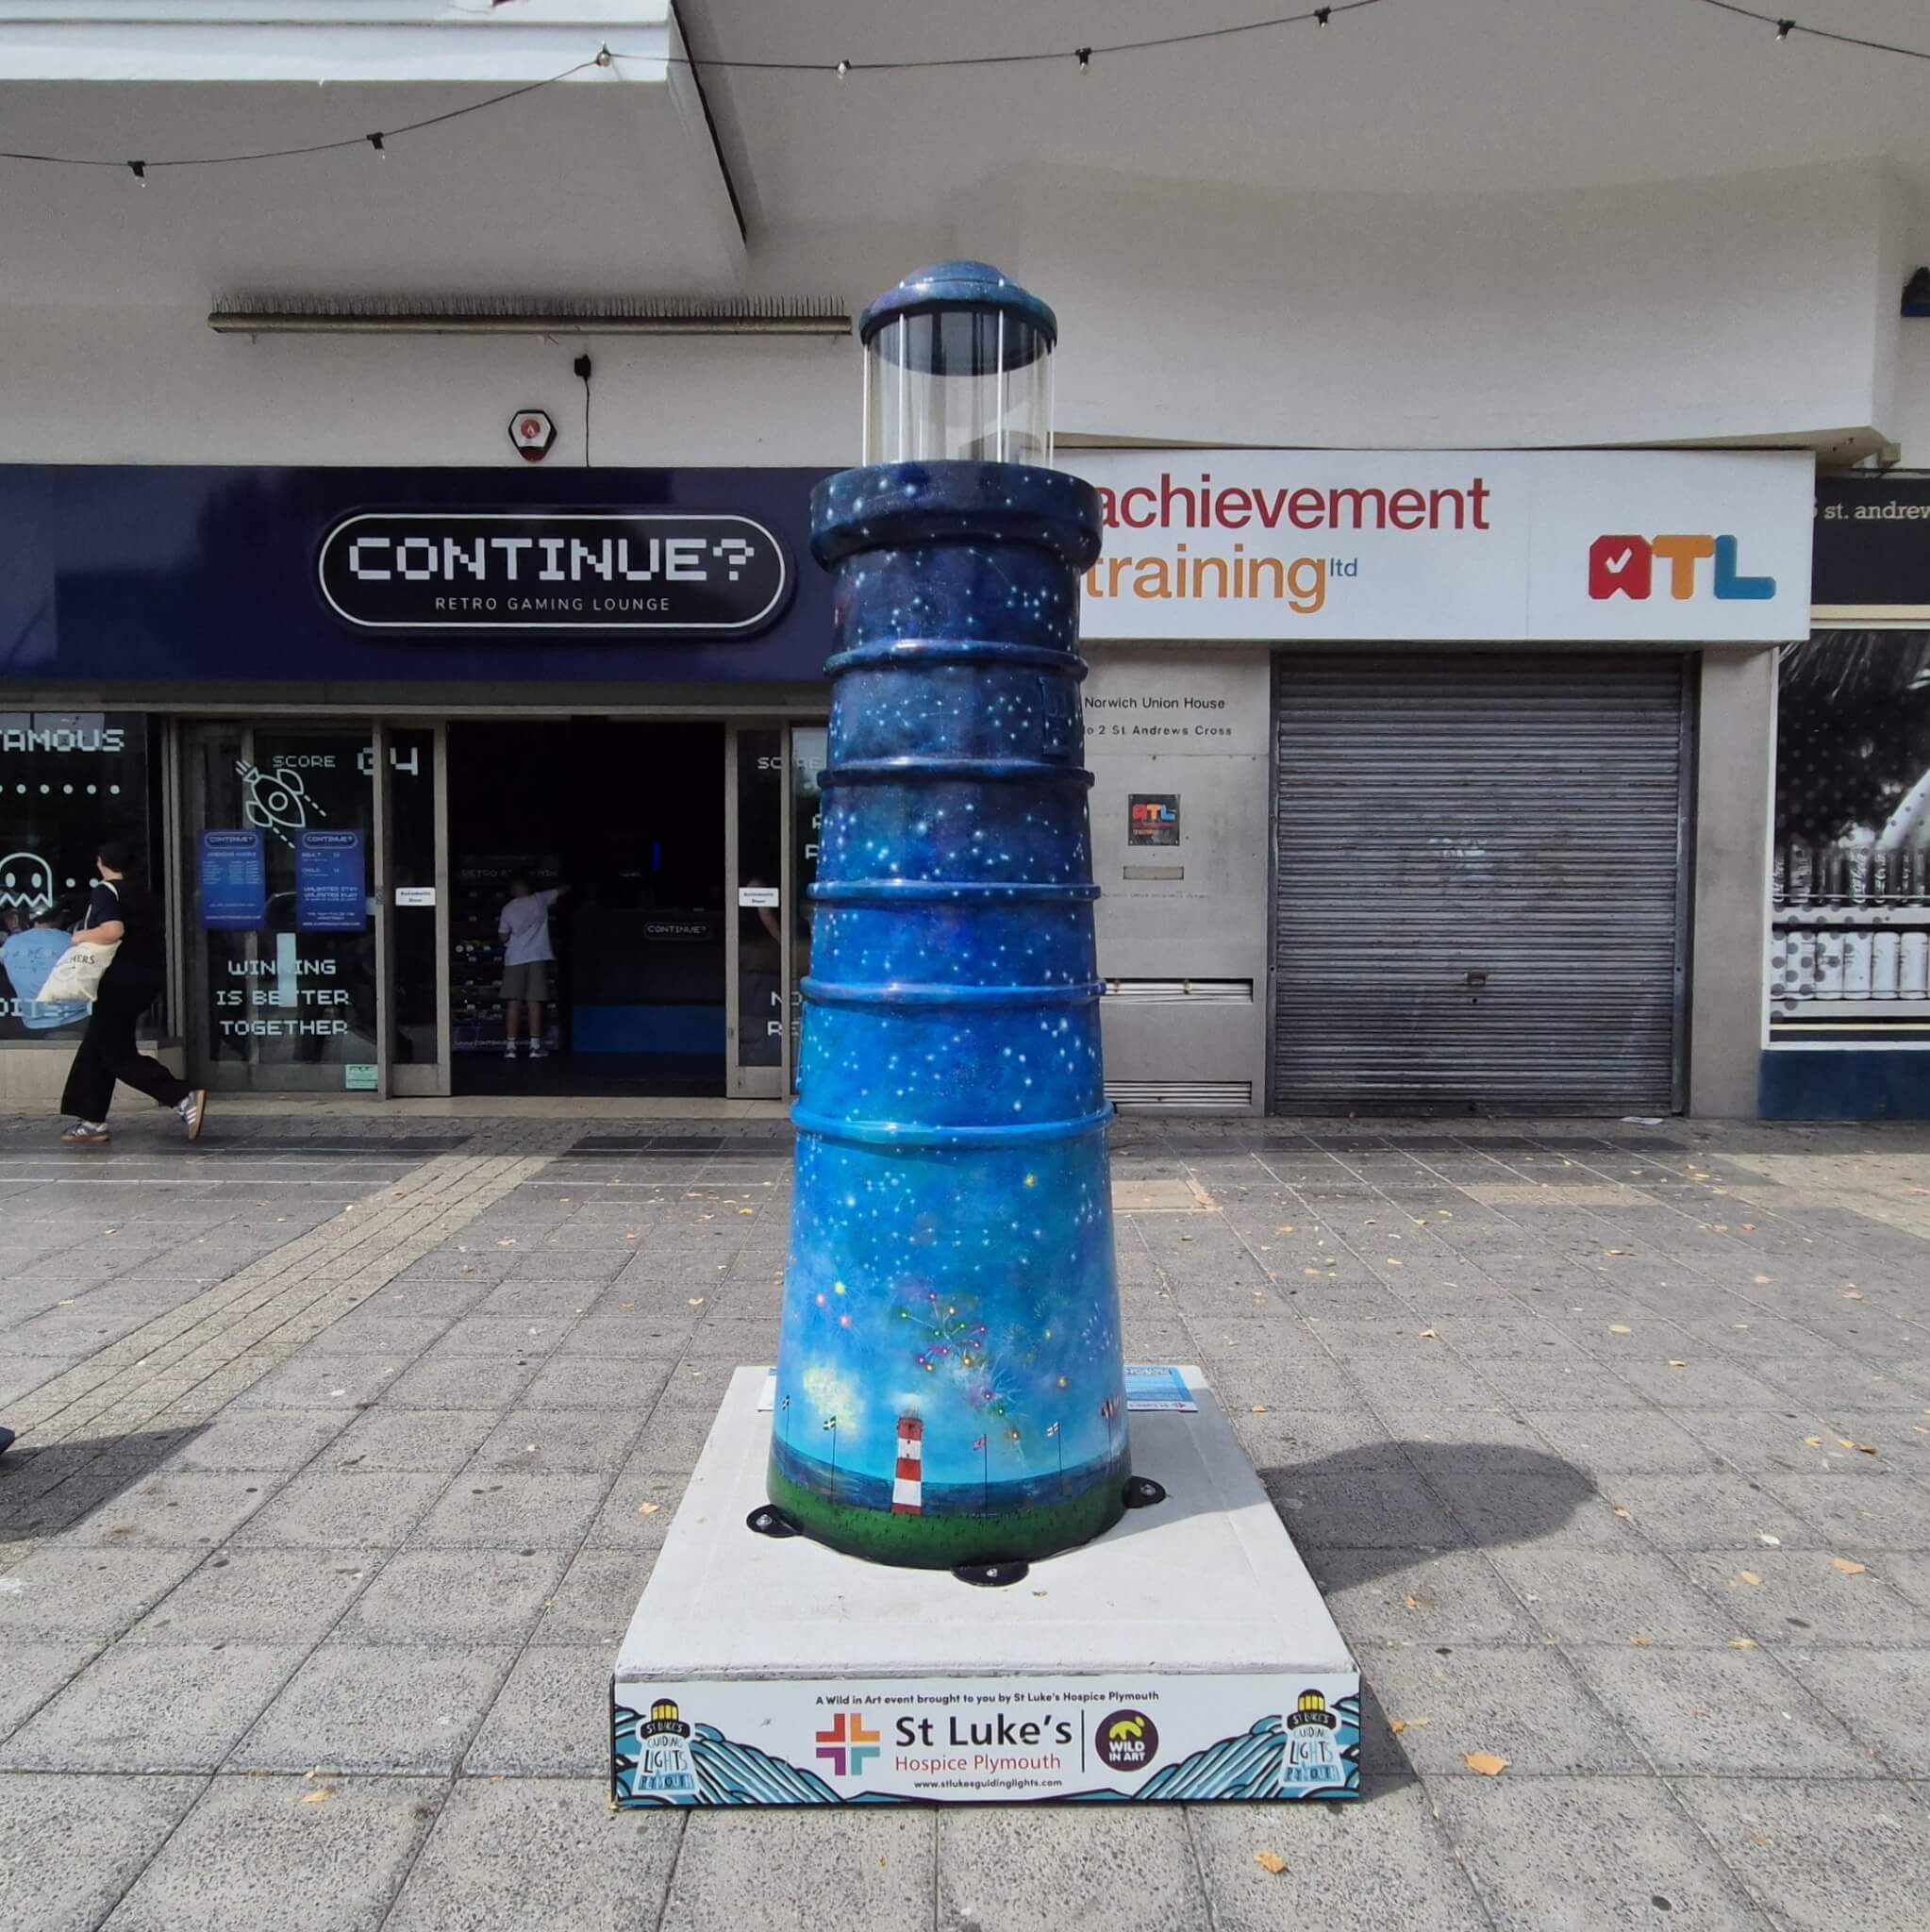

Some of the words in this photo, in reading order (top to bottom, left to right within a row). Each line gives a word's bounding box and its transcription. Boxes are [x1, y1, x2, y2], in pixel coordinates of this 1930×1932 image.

[1094, 474, 1490, 529] achievement
[1824, 503, 1849, 519] st.
[349, 537, 754, 581] CONTINUE?
[1589, 534, 1776, 600] ATL
[1087, 543, 1327, 614] training
[1330, 558, 1358, 577] ltd
[435, 597, 498, 610] RETRO
[507, 597, 583, 610] GAMING
[592, 598, 670, 611] LOUNGE
[1085, 697, 1137, 708] Norwich
[1142, 697, 1179, 708] Union
[1184, 697, 1225, 708] House
[1098, 724, 1106, 735] 2
[1112, 724, 1125, 735] St
[1133, 724, 1189, 735] Andrews
[1195, 724, 1232, 735] Cross
[0, 729, 125, 752] AMOUS
[273, 755, 336, 768] SCORE
[1133, 804, 1176, 820] ATL
[228, 959, 337, 975] WINING
[216, 991, 242, 1006] IS
[252, 991, 350, 1005] BETER
[219, 1020, 348, 1036] TOGETHER
[816, 1696, 824, 1705] A
[826, 1695, 850, 1705] Wild
[853, 1695, 862, 1705] in
[865, 1695, 881, 1705] Art
[885, 1695, 914, 1704] event
[917, 1693, 960, 1706] brought
[963, 1694, 973, 1703] to
[976, 1695, 995, 1706] you
[999, 1692, 1011, 1705] by
[1014, 1692, 1024, 1702] St
[1028, 1692, 1060, 1702] Luke's
[1063, 1691, 1106, 1704] Hospice
[1108, 1690, 1159, 1703] Plymouth
[896, 1716, 934, 1746] St
[950, 1713, 1073, 1745] Luke's
[1109, 1740, 1145, 1752] WILD
[1289, 1740, 1333, 1765] LIGHTS
[644, 1749, 688, 1774] LIGHTS
[896, 1756, 967, 1774] Hospice
[974, 1753, 1061, 1774] Plymouth
[1109, 1753, 1122, 1761] IN
[1123, 1752, 1145, 1761] ART
[914, 1778, 1063, 1790] www.stlukesguidinglights.com
